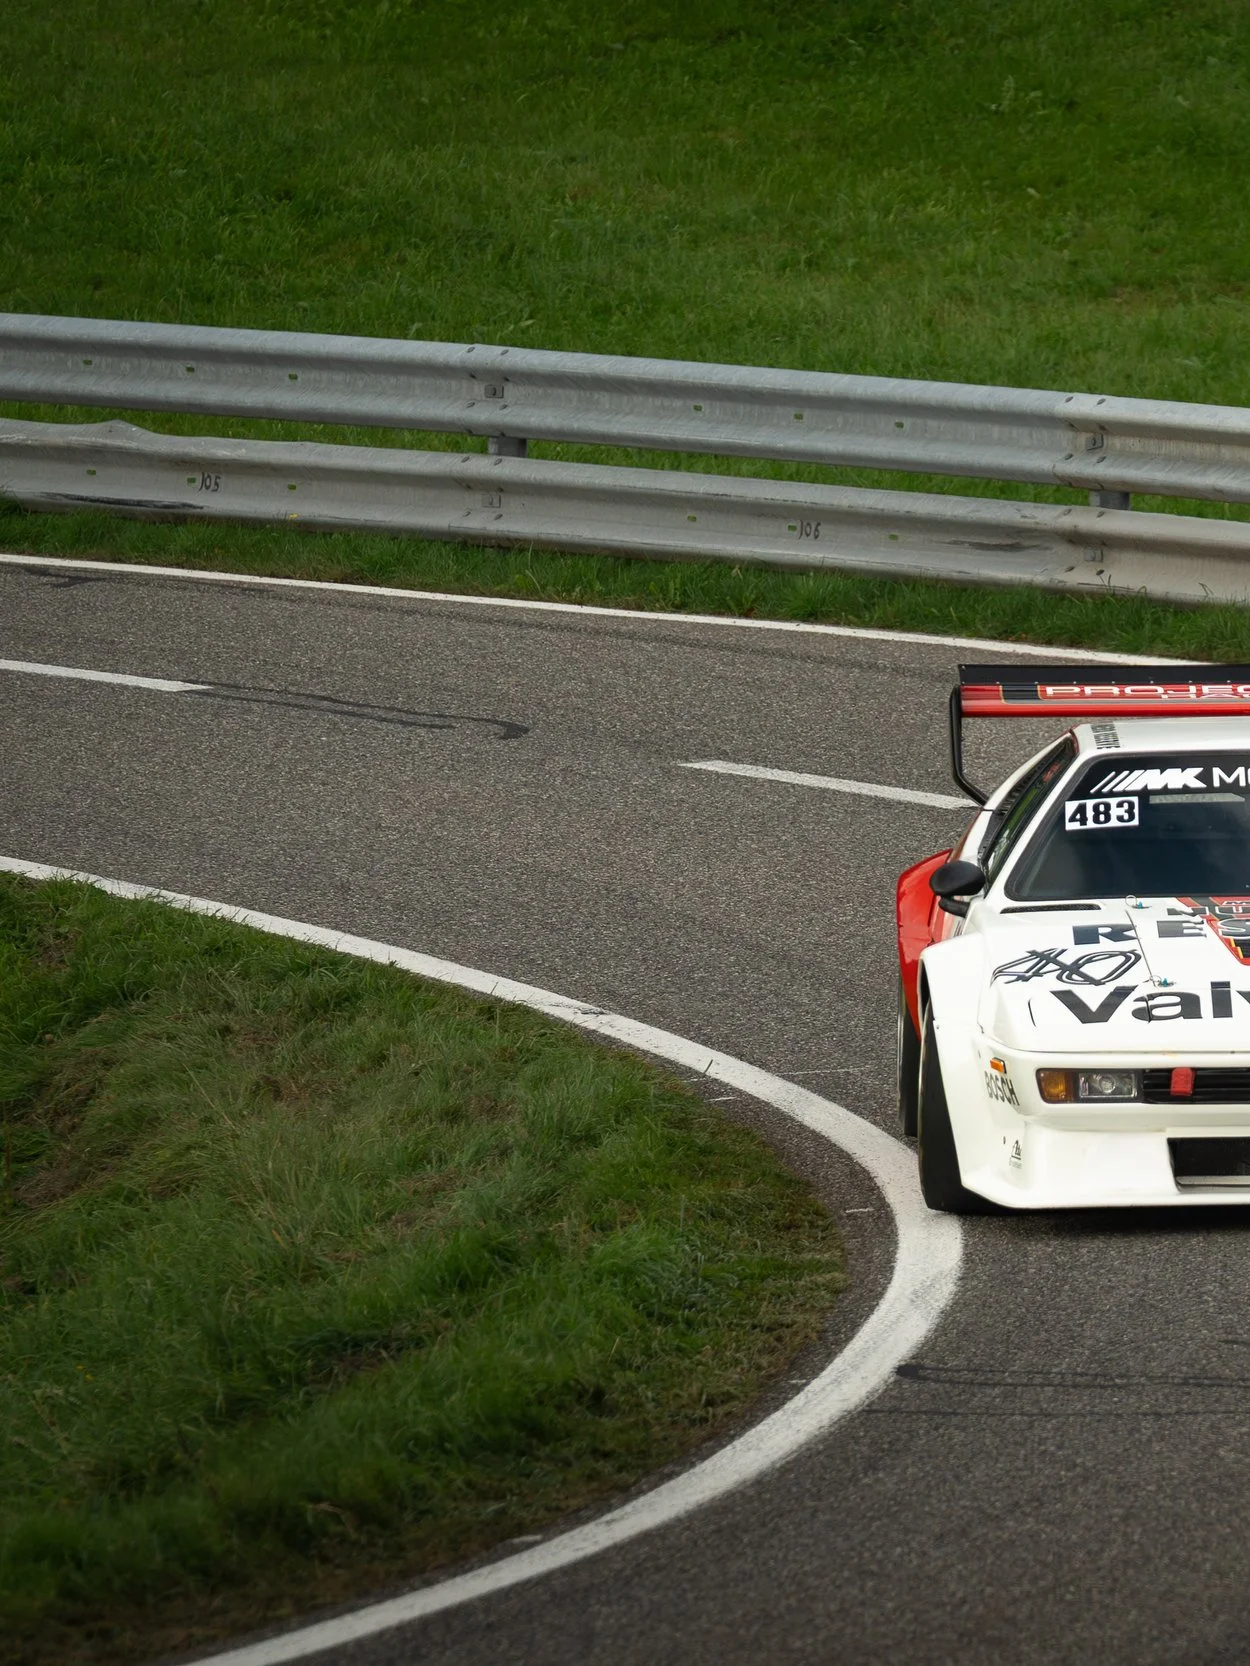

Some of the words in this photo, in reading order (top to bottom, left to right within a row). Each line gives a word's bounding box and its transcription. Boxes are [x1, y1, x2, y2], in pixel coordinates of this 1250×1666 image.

[199, 471, 221, 492] 105
[798, 520, 821, 540] 106
[1068, 799, 1136, 826] 483
[984, 1069, 1020, 1106] BOSCH
